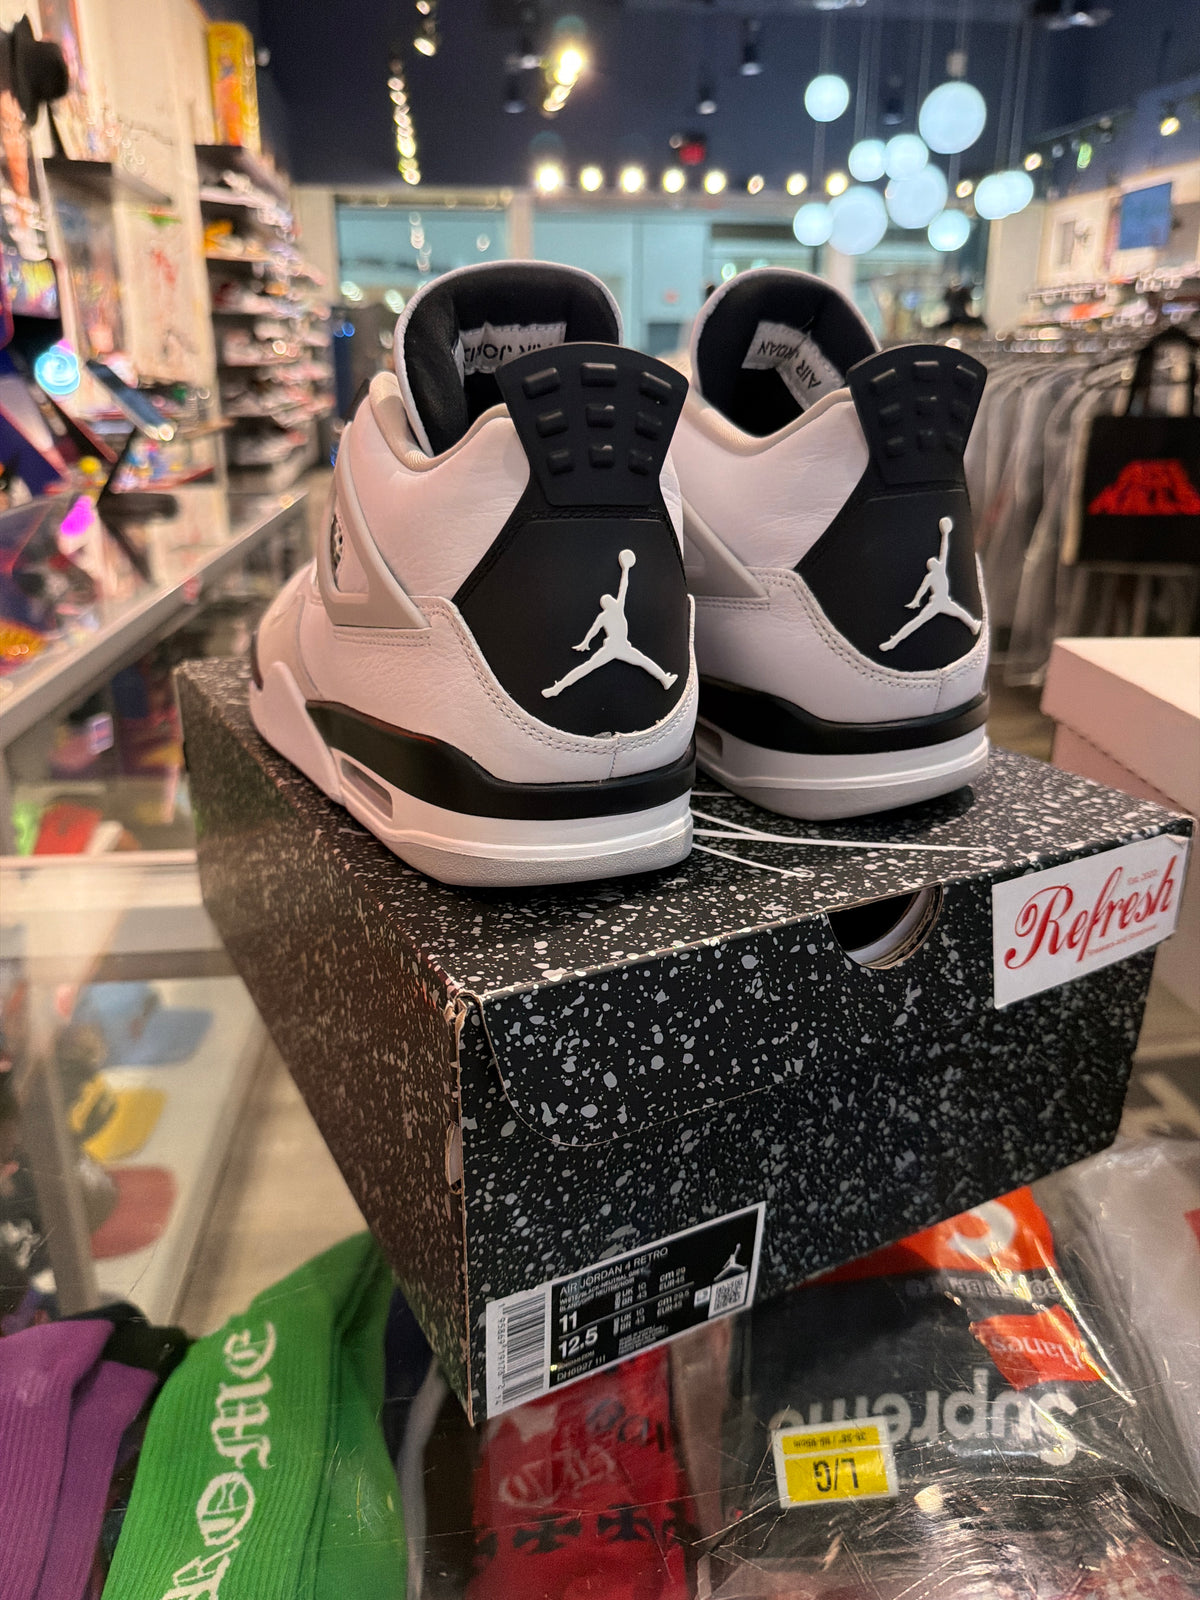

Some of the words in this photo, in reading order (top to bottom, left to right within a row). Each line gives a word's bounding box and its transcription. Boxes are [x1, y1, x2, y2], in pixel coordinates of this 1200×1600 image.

[795, 360, 821, 389] AIR
[1003, 854, 1177, 970] Refresh
[560, 1281, 578, 1297] AIR
[580, 1264, 623, 1288] JORDAN
[625, 1260, 631, 1271] 4
[633, 1246, 669, 1266] RETRO
[622, 1286, 634, 1297] UK
[638, 1282, 647, 1291] 10
[559, 1310, 578, 1332] 11
[559, 1325, 598, 1359] 12.5
[813, 1457, 859, 1492] L/G
